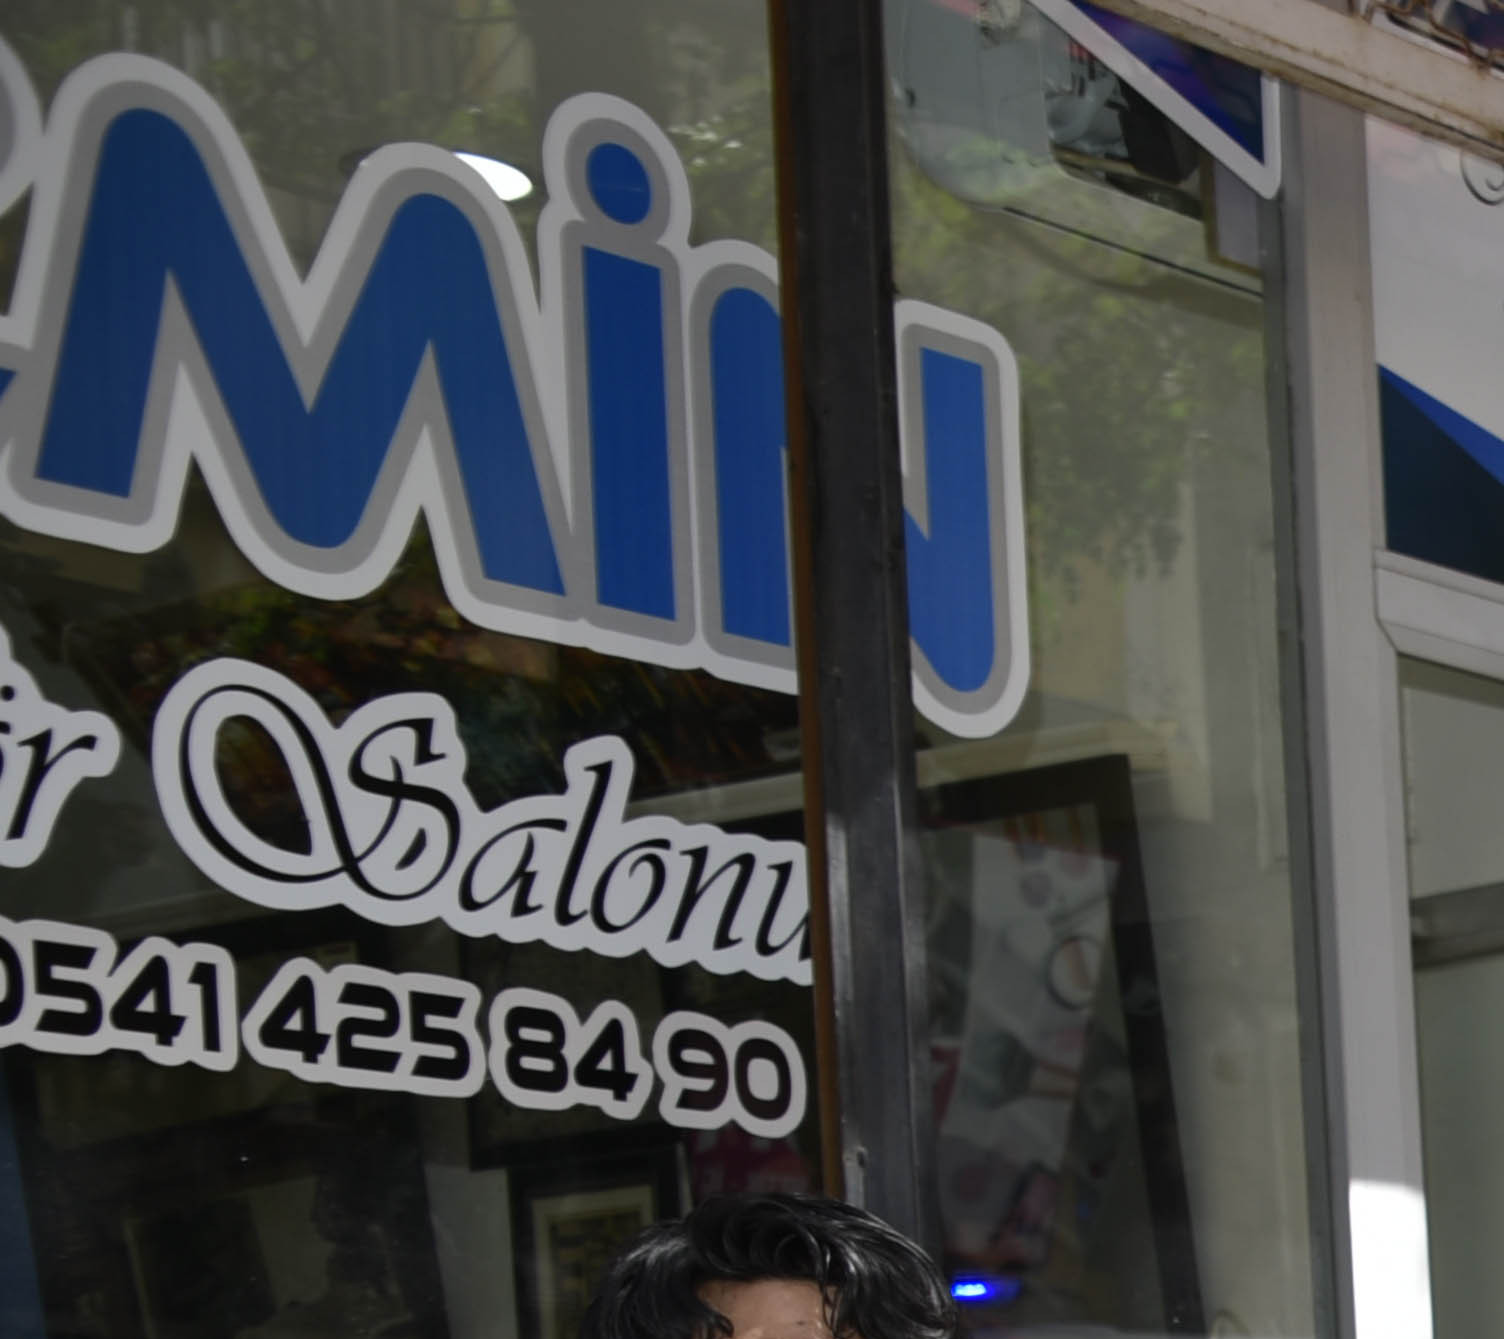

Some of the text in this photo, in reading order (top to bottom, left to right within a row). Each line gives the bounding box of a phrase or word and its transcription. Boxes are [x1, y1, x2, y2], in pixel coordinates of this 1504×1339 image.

[258, 973, 474, 1083] 425
[504, 1004, 640, 1103] 84
[666, 1028, 794, 1122] 90
